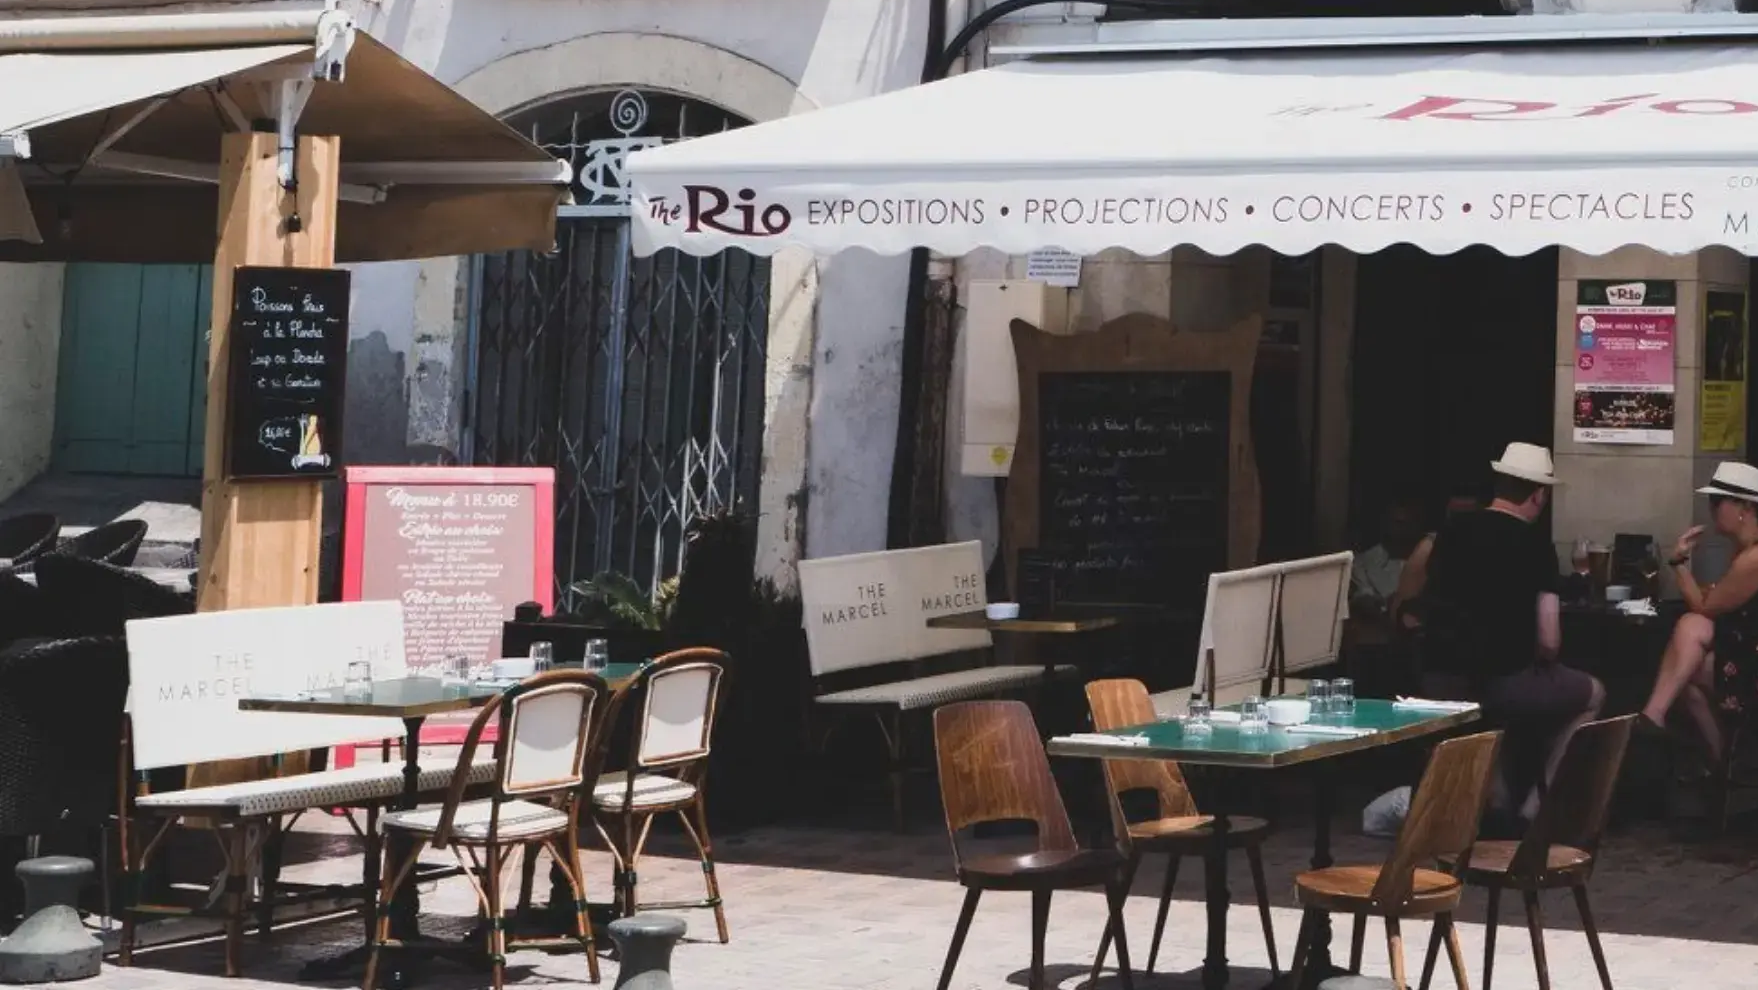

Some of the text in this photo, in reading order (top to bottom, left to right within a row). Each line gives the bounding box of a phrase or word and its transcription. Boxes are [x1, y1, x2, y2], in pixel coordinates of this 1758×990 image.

[648, 195, 683, 226] The
[683, 185, 791, 236] Rio
[806, 197, 986, 226] EXPOSITIONS
[1024, 195, 1229, 225] PROJECTIONS
[1272, 193, 1445, 224] CONCERTS
[1488, 190, 1695, 222] SPECTACLES
[954, 573, 977, 589] THE
[858, 583, 886, 599] THE
[921, 593, 980, 611] MARCEL
[822, 603, 888, 625] MARCEL
[214, 653, 253, 670] THE
[159, 677, 254, 701] MARCEL
